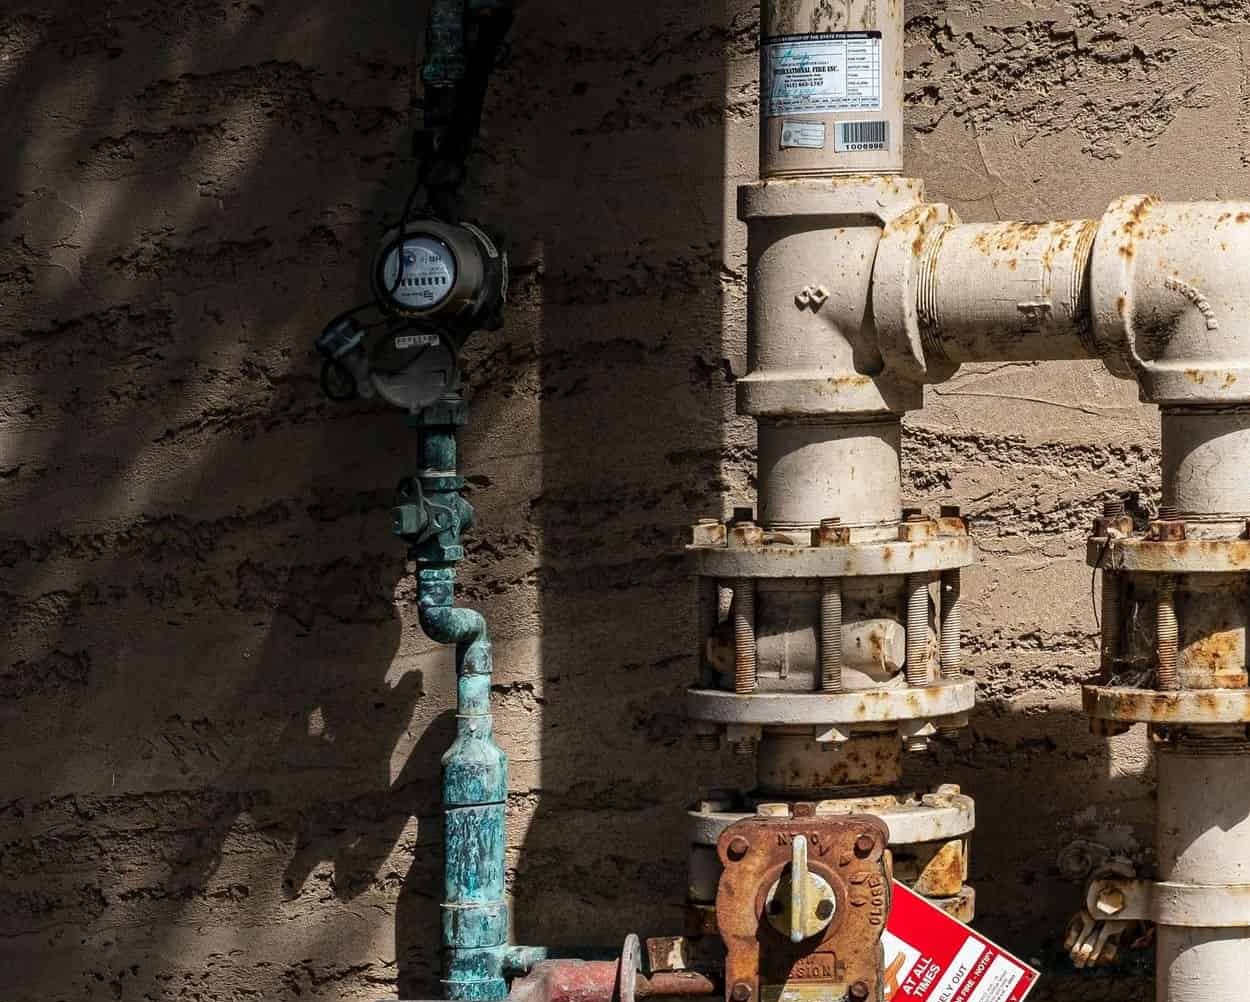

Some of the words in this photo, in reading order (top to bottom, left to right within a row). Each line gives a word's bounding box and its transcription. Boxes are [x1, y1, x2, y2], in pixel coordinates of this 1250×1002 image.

[900, 976, 918, 995] AT
[912, 953, 933, 977] ALL
[912, 962, 941, 998] TIMES
[951, 964, 967, 984] OUT
[960, 978, 975, 996] FIRE
[973, 949, 994, 976] NOTIFY
